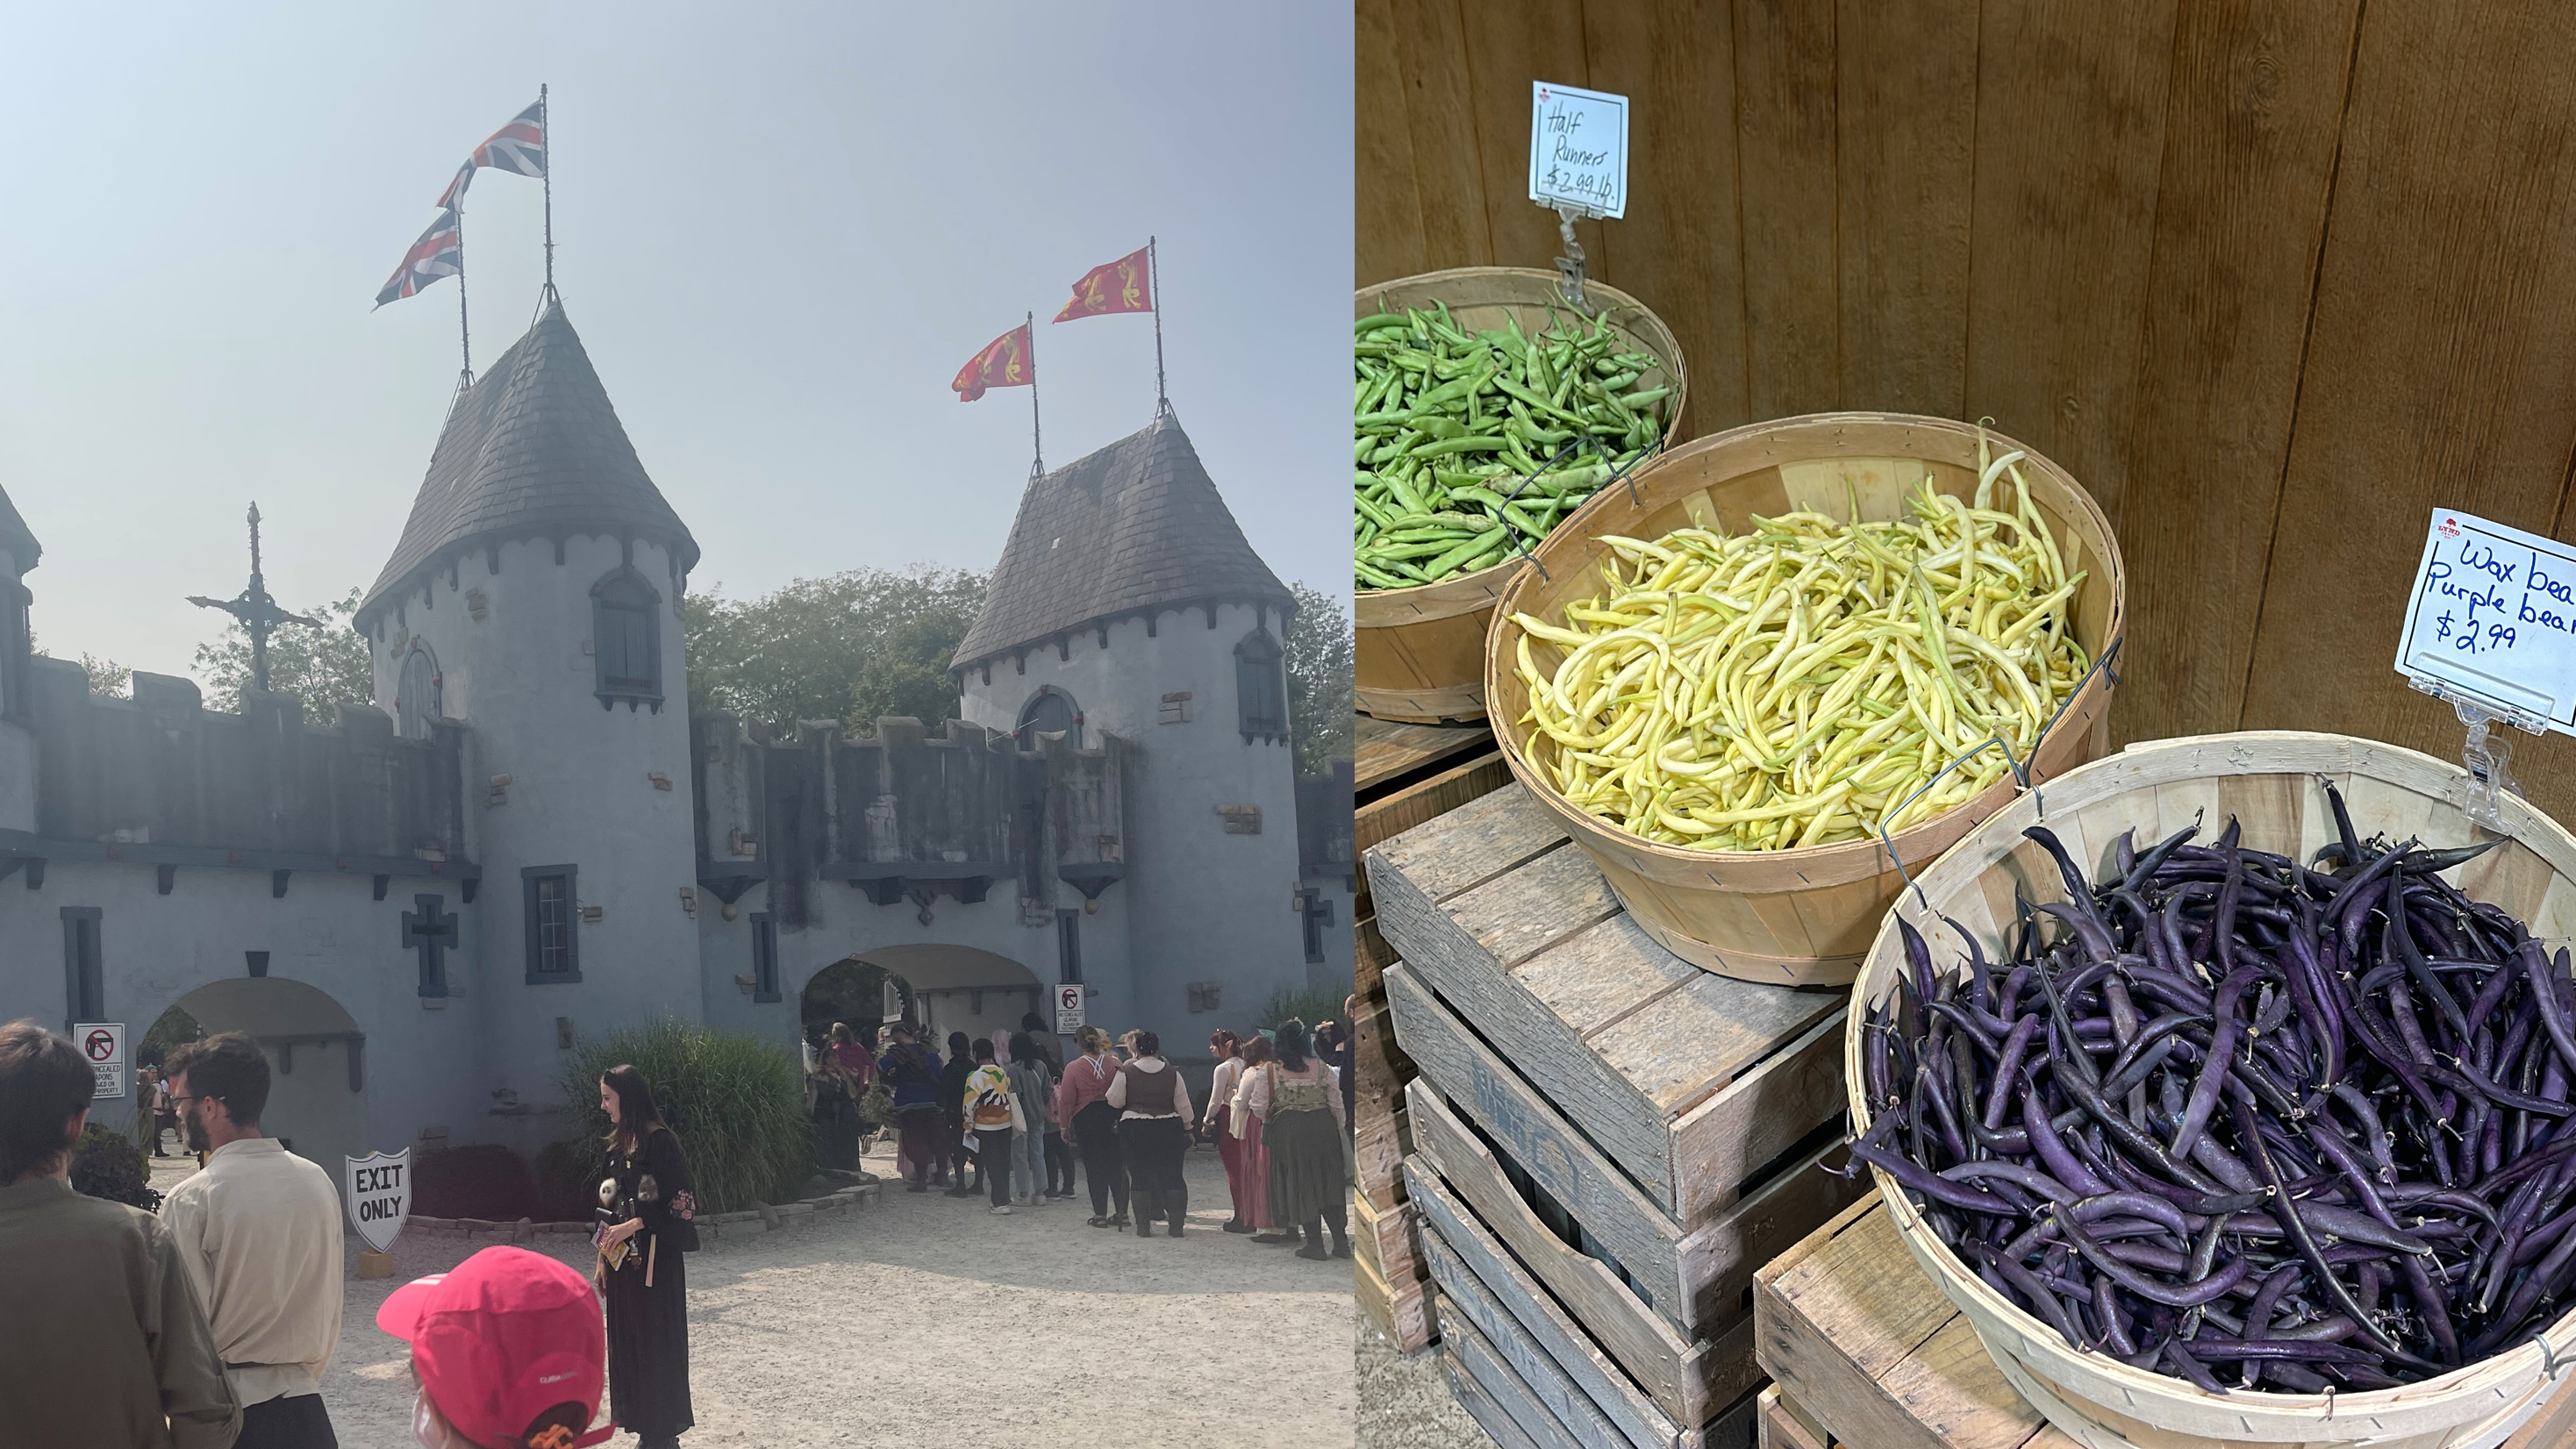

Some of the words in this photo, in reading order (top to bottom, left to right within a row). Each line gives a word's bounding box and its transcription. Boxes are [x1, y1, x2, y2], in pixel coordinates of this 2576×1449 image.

[1548, 100, 1584, 134] Half
[1552, 134, 1608, 167] Runners
[2459, 539, 2516, 583] Wax
[2429, 561, 2506, 619] Purple
[356, 1164, 404, 1193] EXIT
[360, 1196, 402, 1223] ONLY
